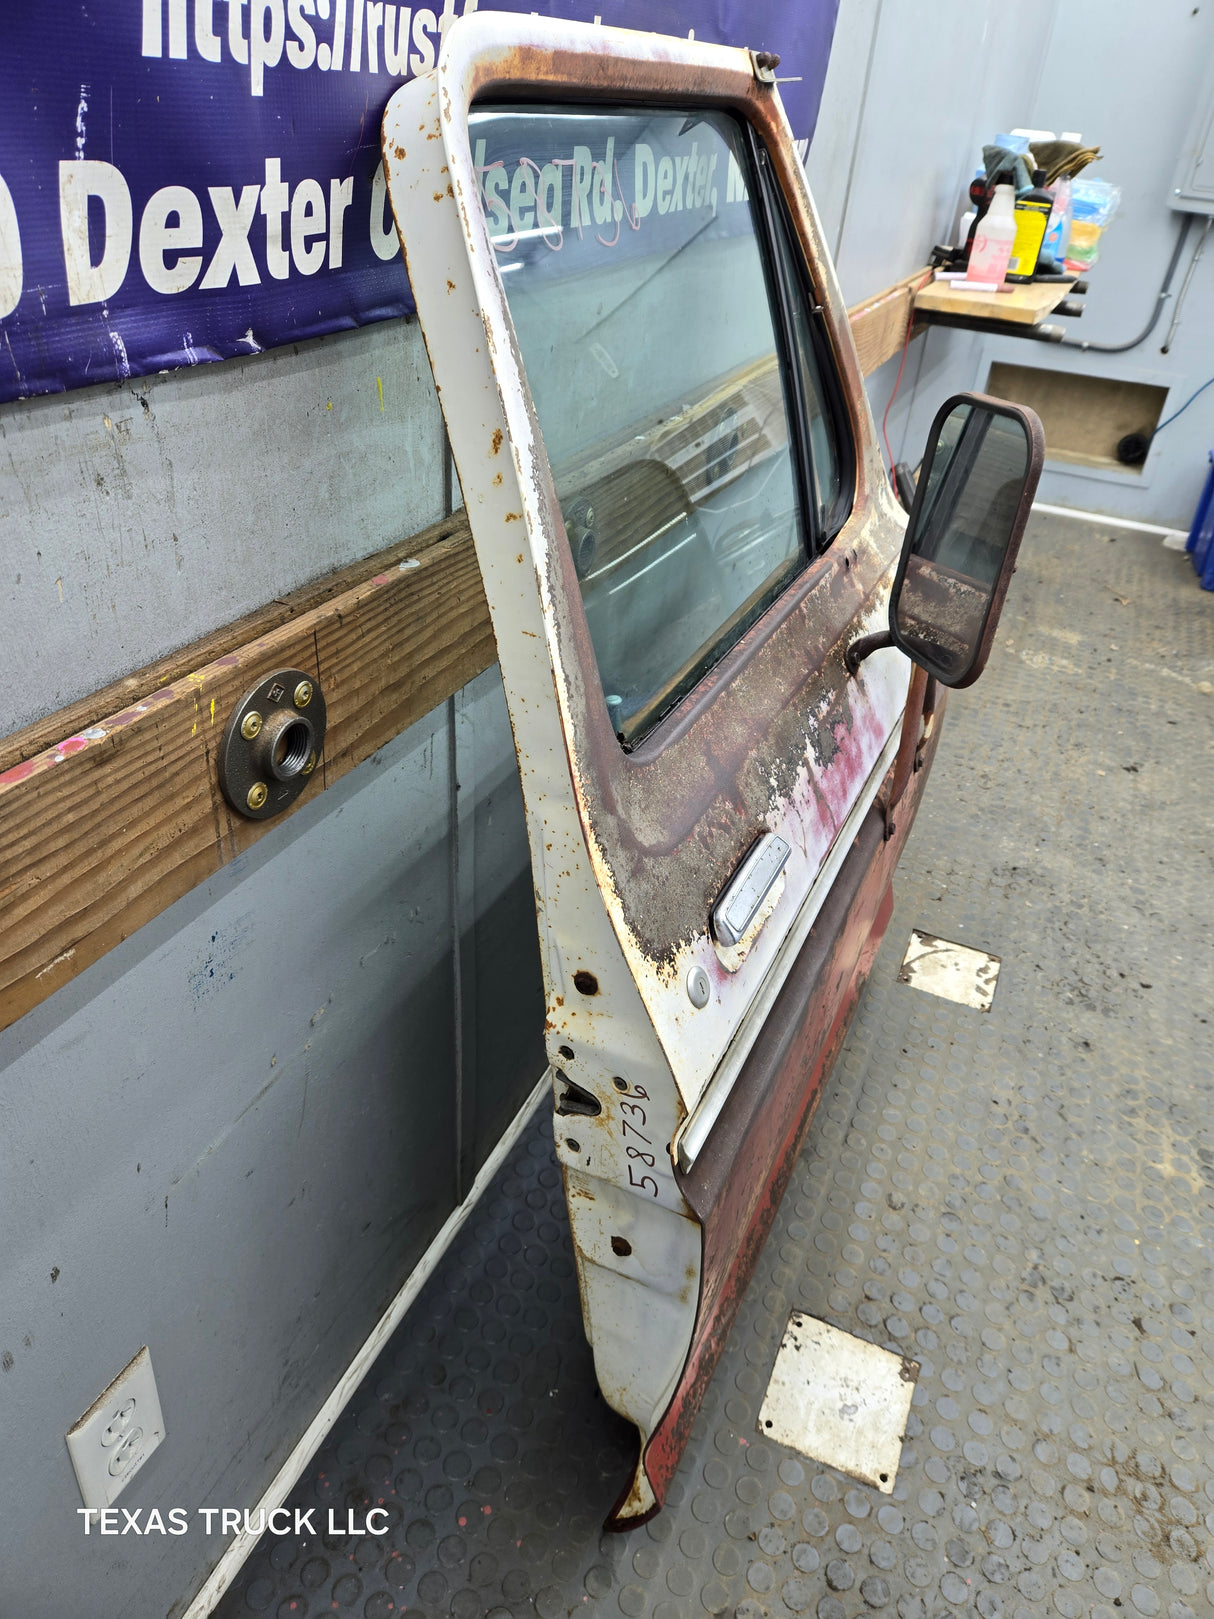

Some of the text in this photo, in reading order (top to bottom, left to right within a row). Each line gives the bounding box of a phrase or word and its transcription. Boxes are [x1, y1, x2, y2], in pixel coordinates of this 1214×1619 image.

[58, 158, 353, 306] Dexter
[570, 137, 624, 228] Rd.
[633, 143, 719, 218] Dexter,
[619, 1085, 659, 1198] 58736
